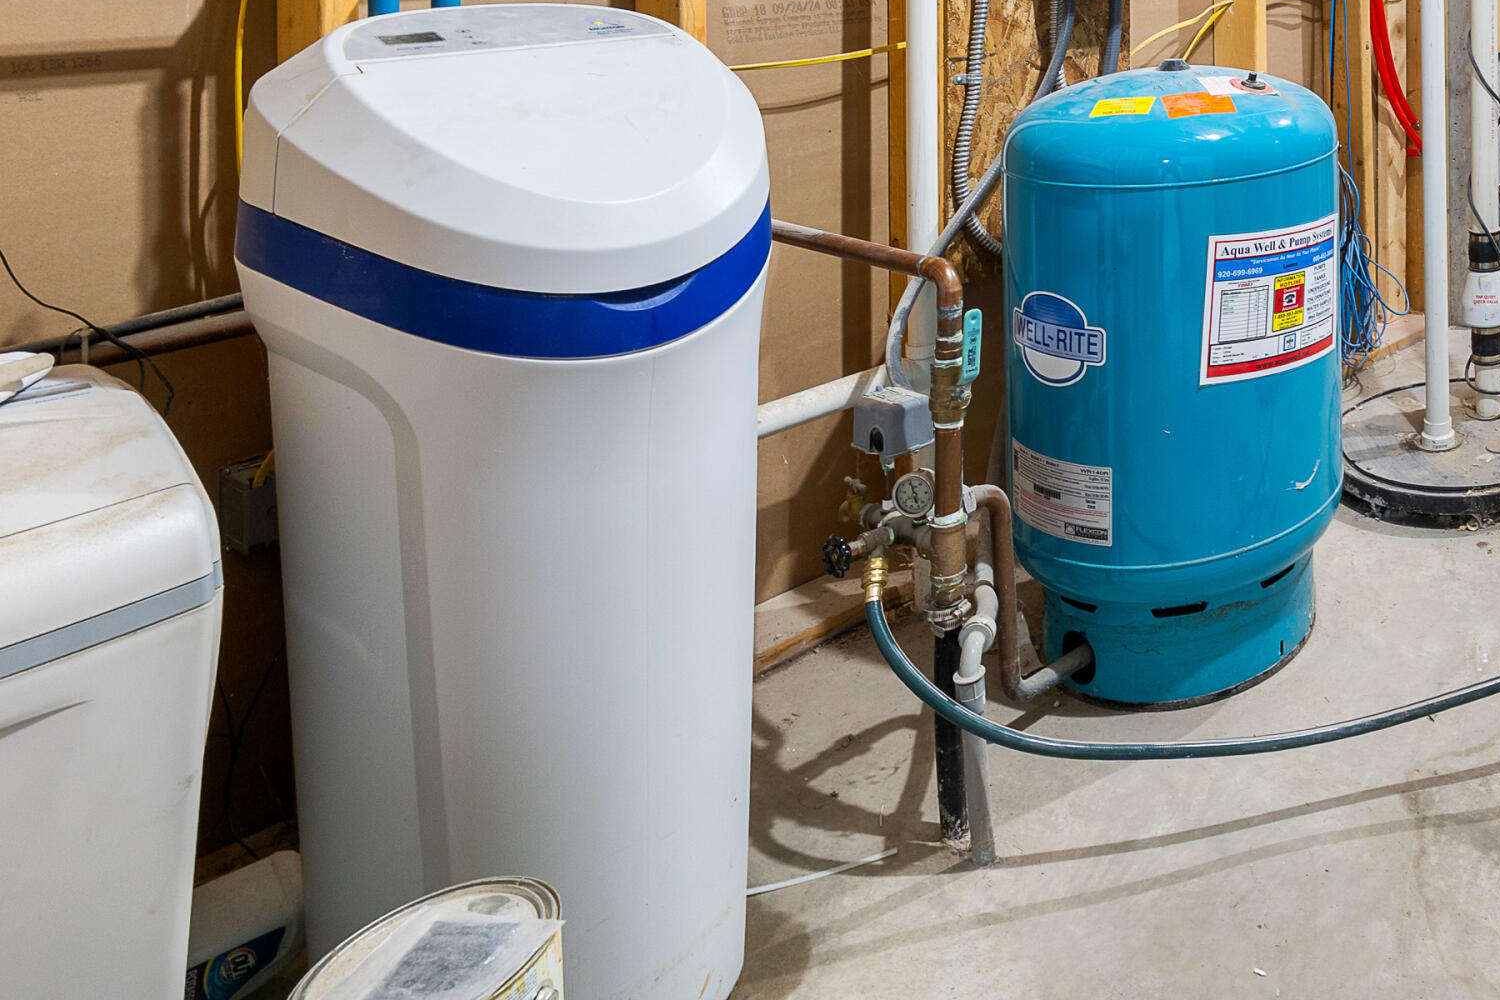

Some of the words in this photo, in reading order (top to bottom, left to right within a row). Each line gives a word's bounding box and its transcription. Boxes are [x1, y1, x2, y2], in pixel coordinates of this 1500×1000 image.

[1220, 245, 1251, 258] Aqua
[1254, 240, 1276, 253] Well
[1278, 239, 1286, 250] &
[1289, 235, 1311, 248] Pump
[1312, 228, 1332, 241] Systems
[1280, 279, 1302, 288] HOTLINE
[1016, 314, 1099, 356] WELL-RITE
[1076, 523, 1107, 536] FLEXCON
